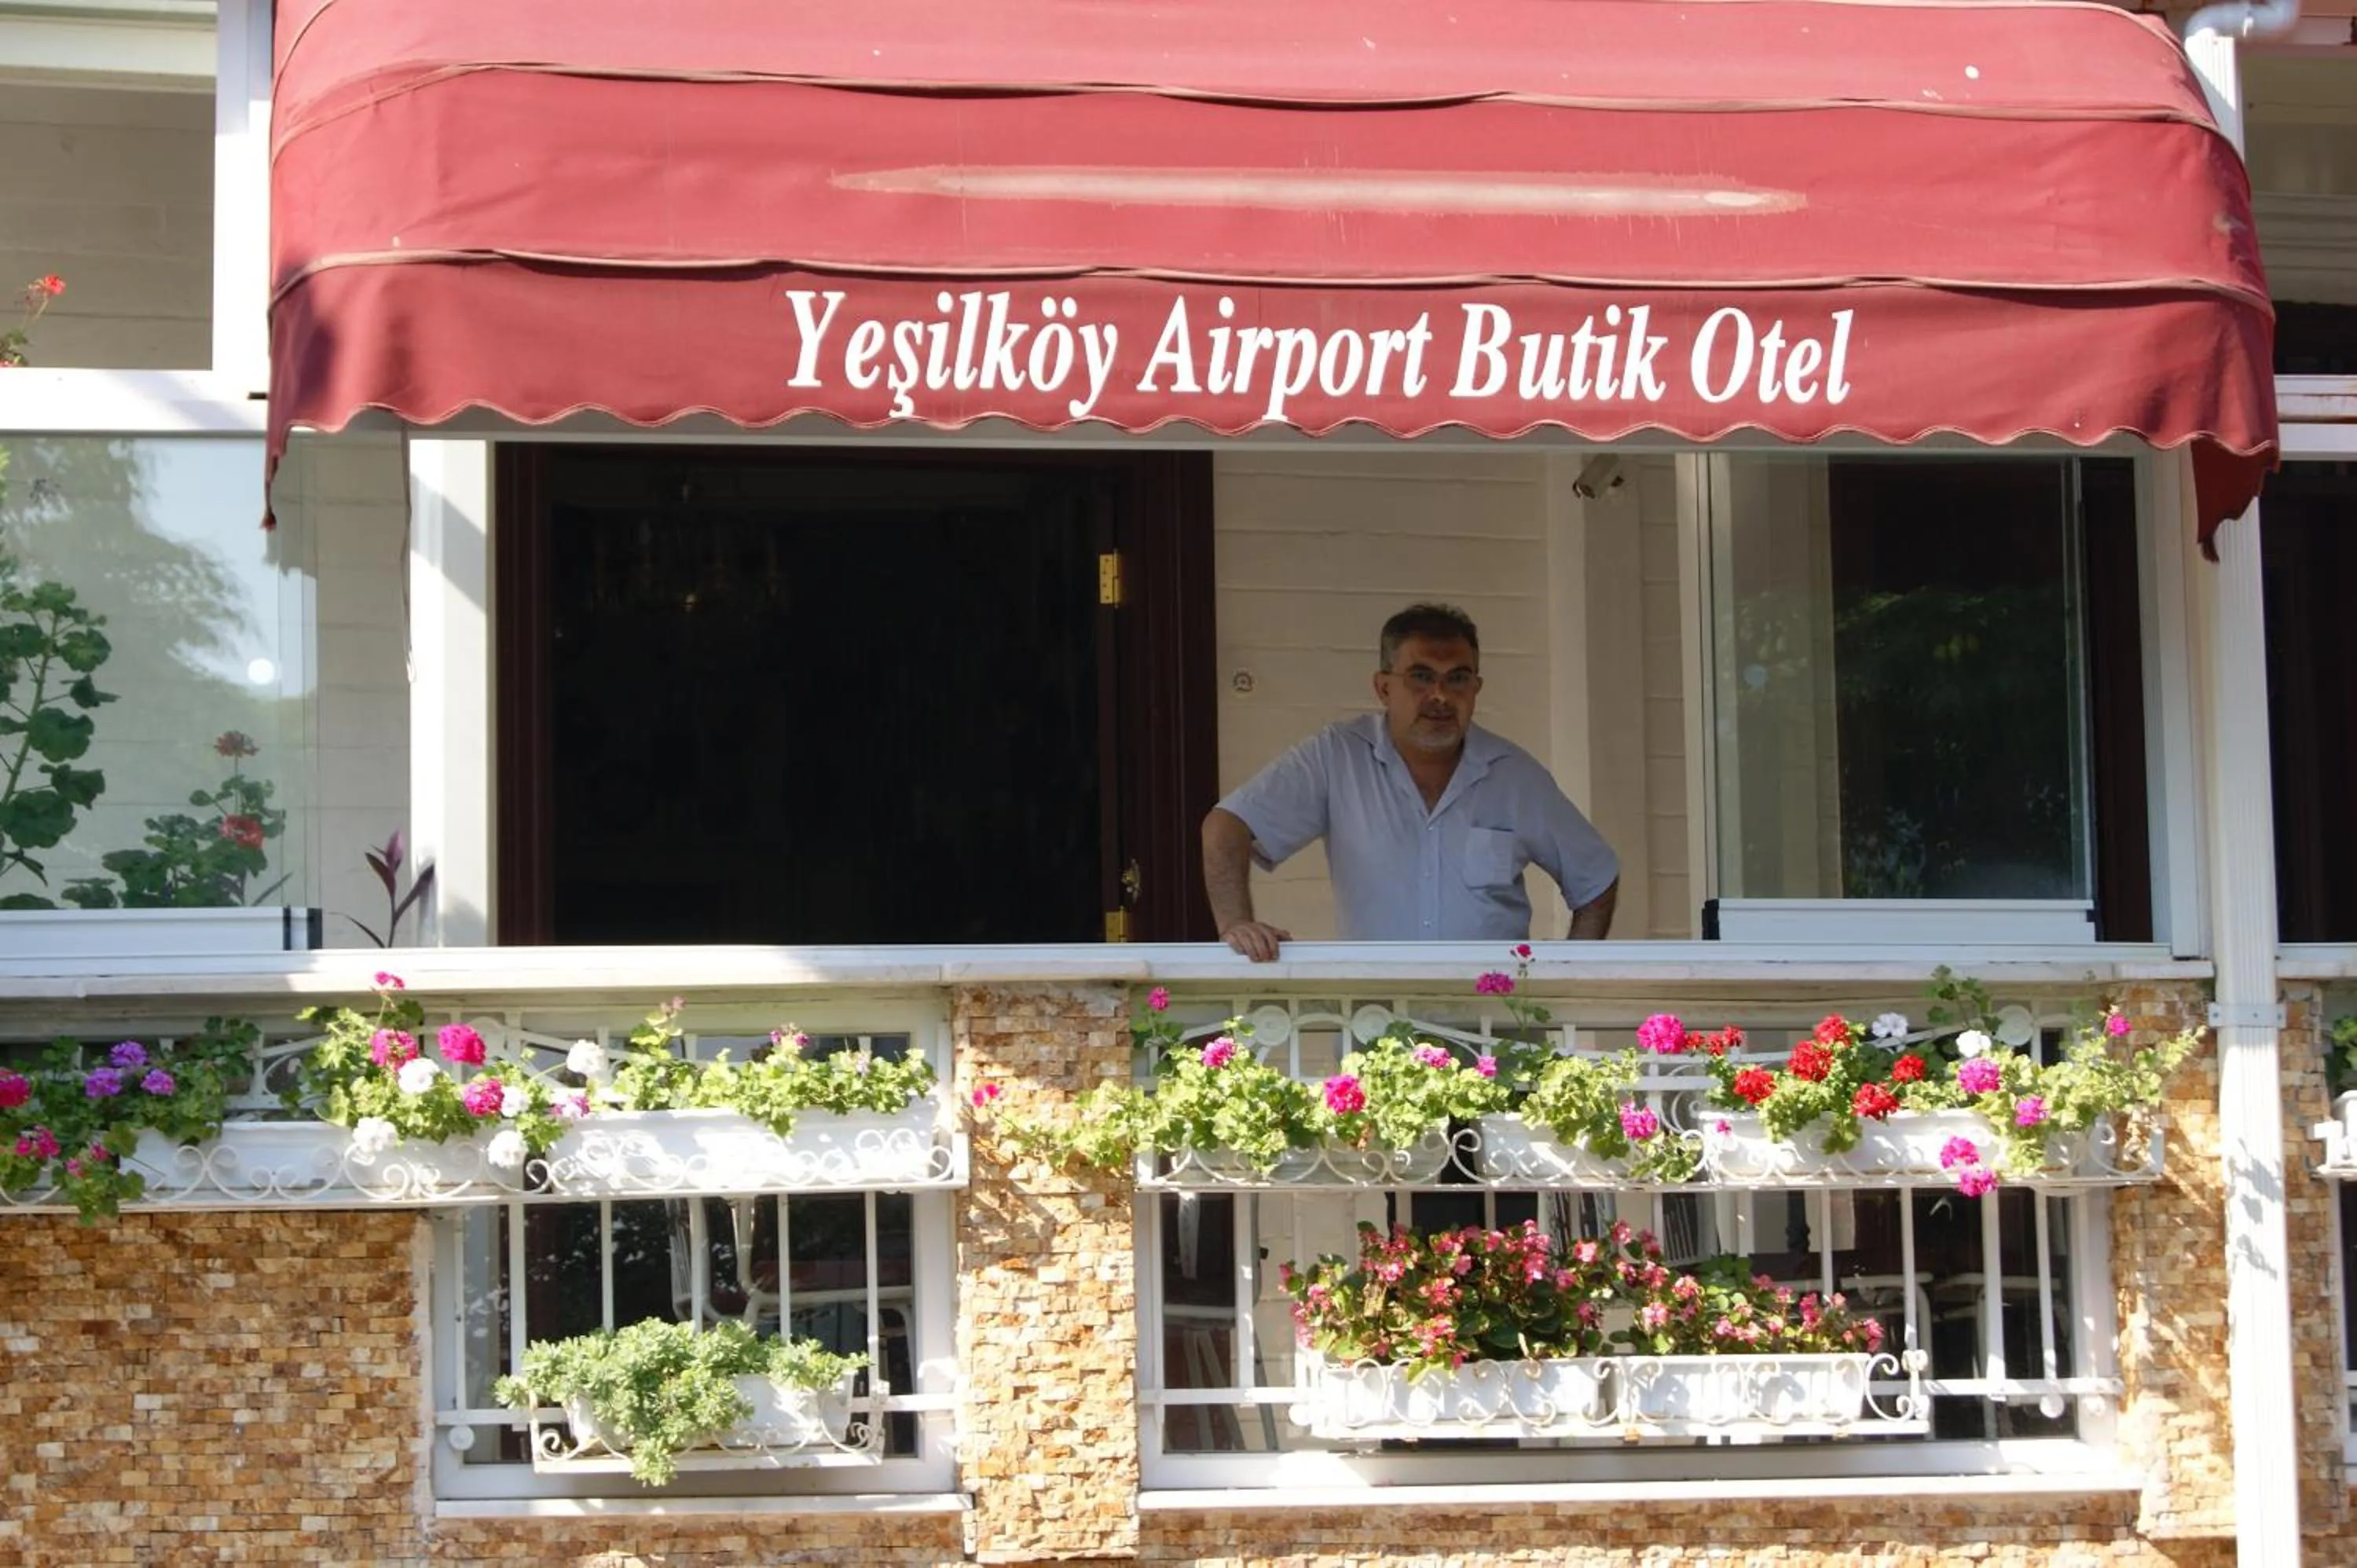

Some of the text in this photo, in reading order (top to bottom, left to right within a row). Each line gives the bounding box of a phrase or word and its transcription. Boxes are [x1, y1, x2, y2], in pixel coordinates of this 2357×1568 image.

[786, 291, 1854, 421] Yeşilköy Airport Butik Otel
